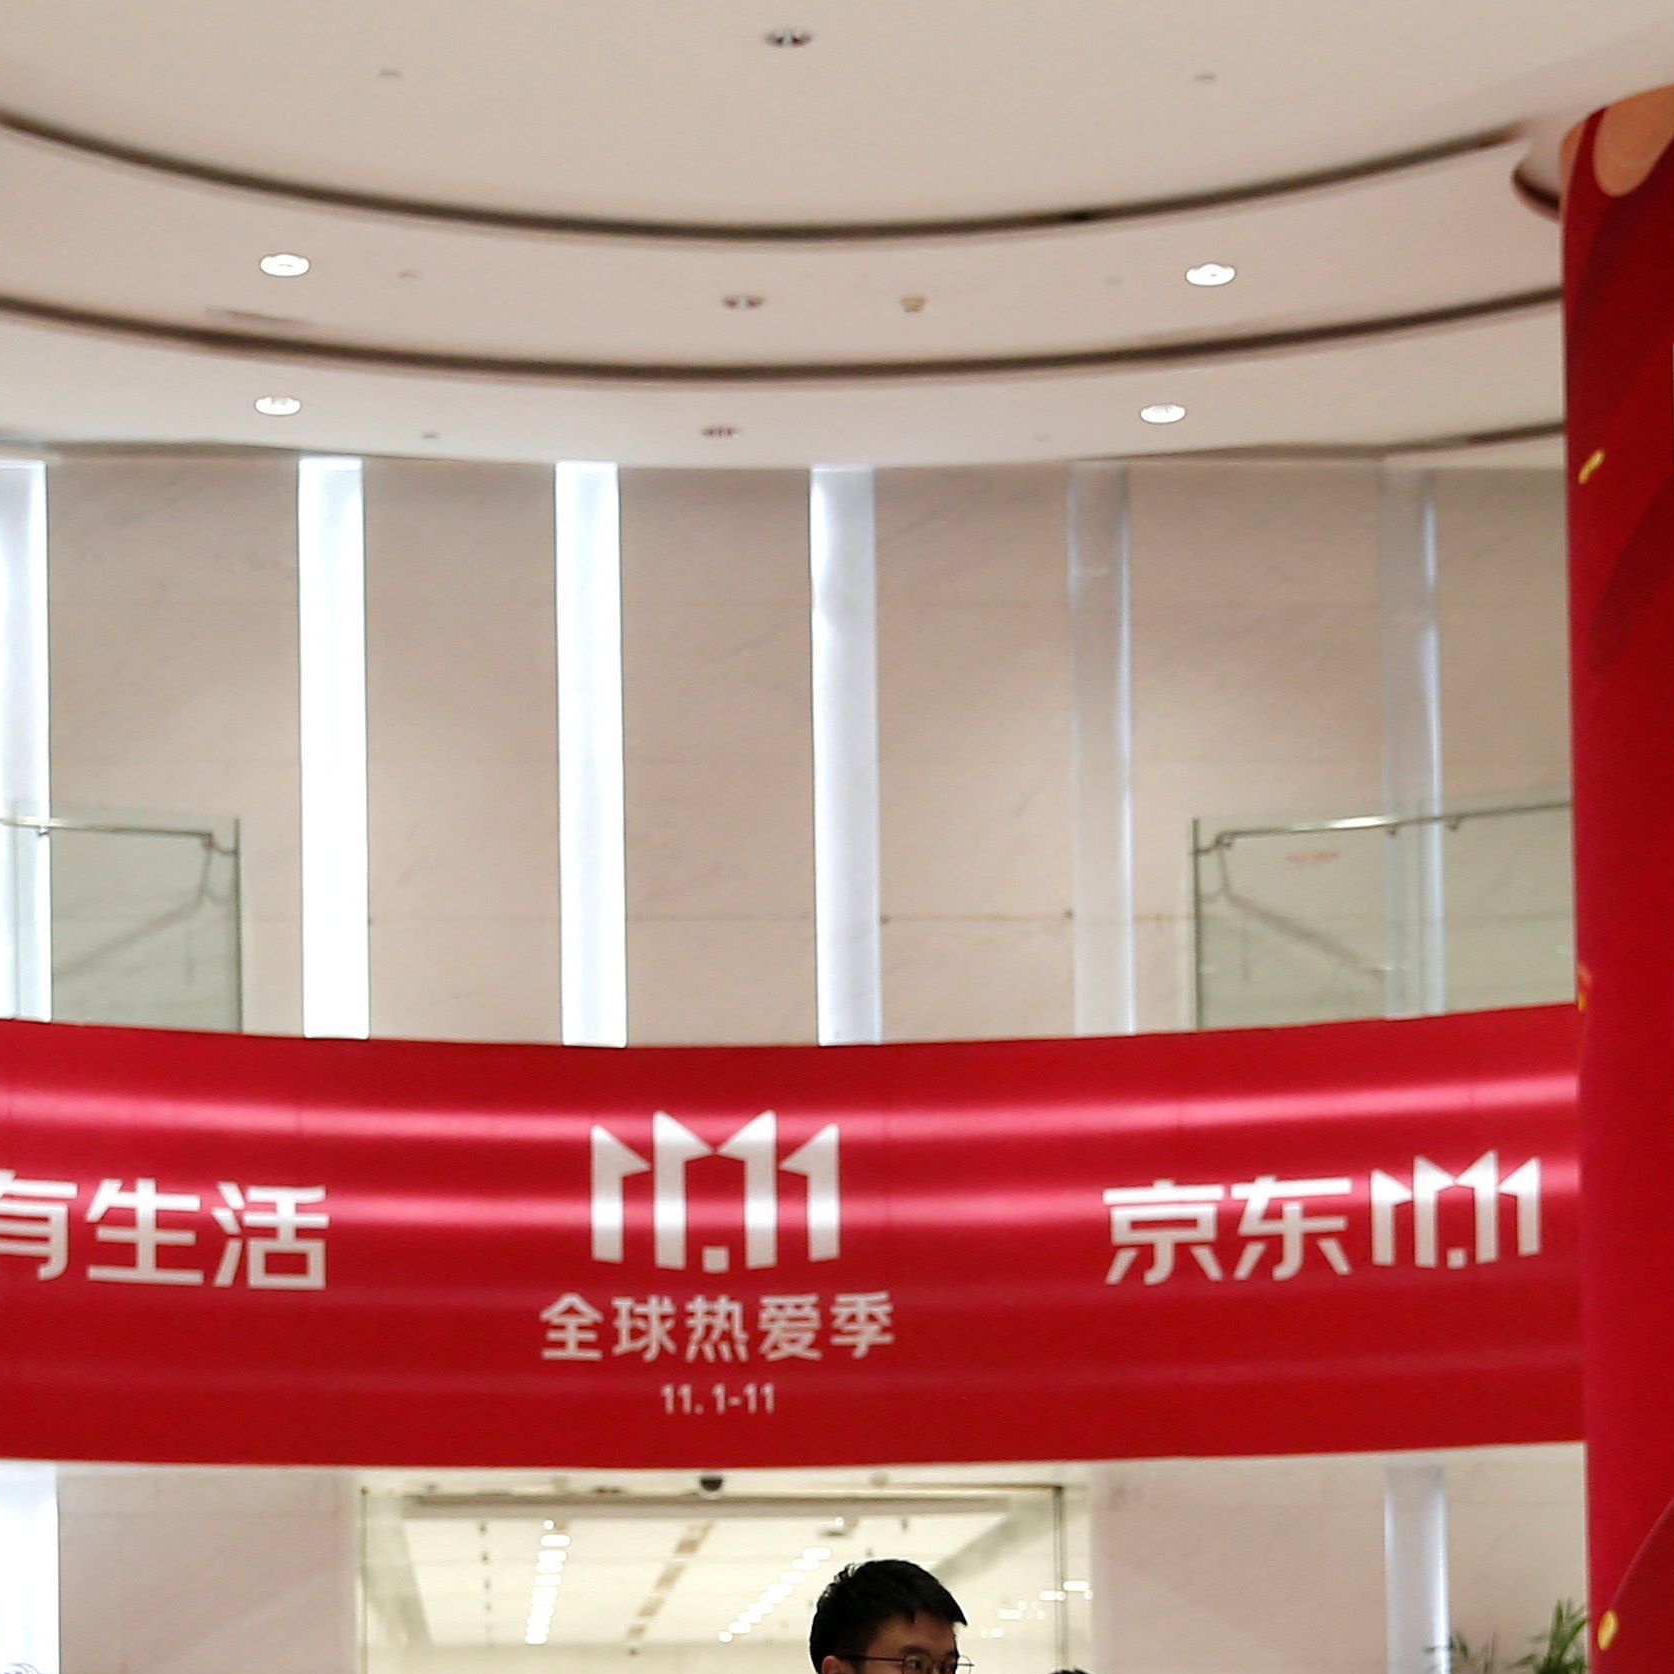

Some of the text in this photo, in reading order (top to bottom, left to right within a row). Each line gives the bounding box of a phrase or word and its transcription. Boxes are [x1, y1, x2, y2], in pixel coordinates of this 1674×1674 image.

[540, 1291, 895, 1362] 全球热爱季
